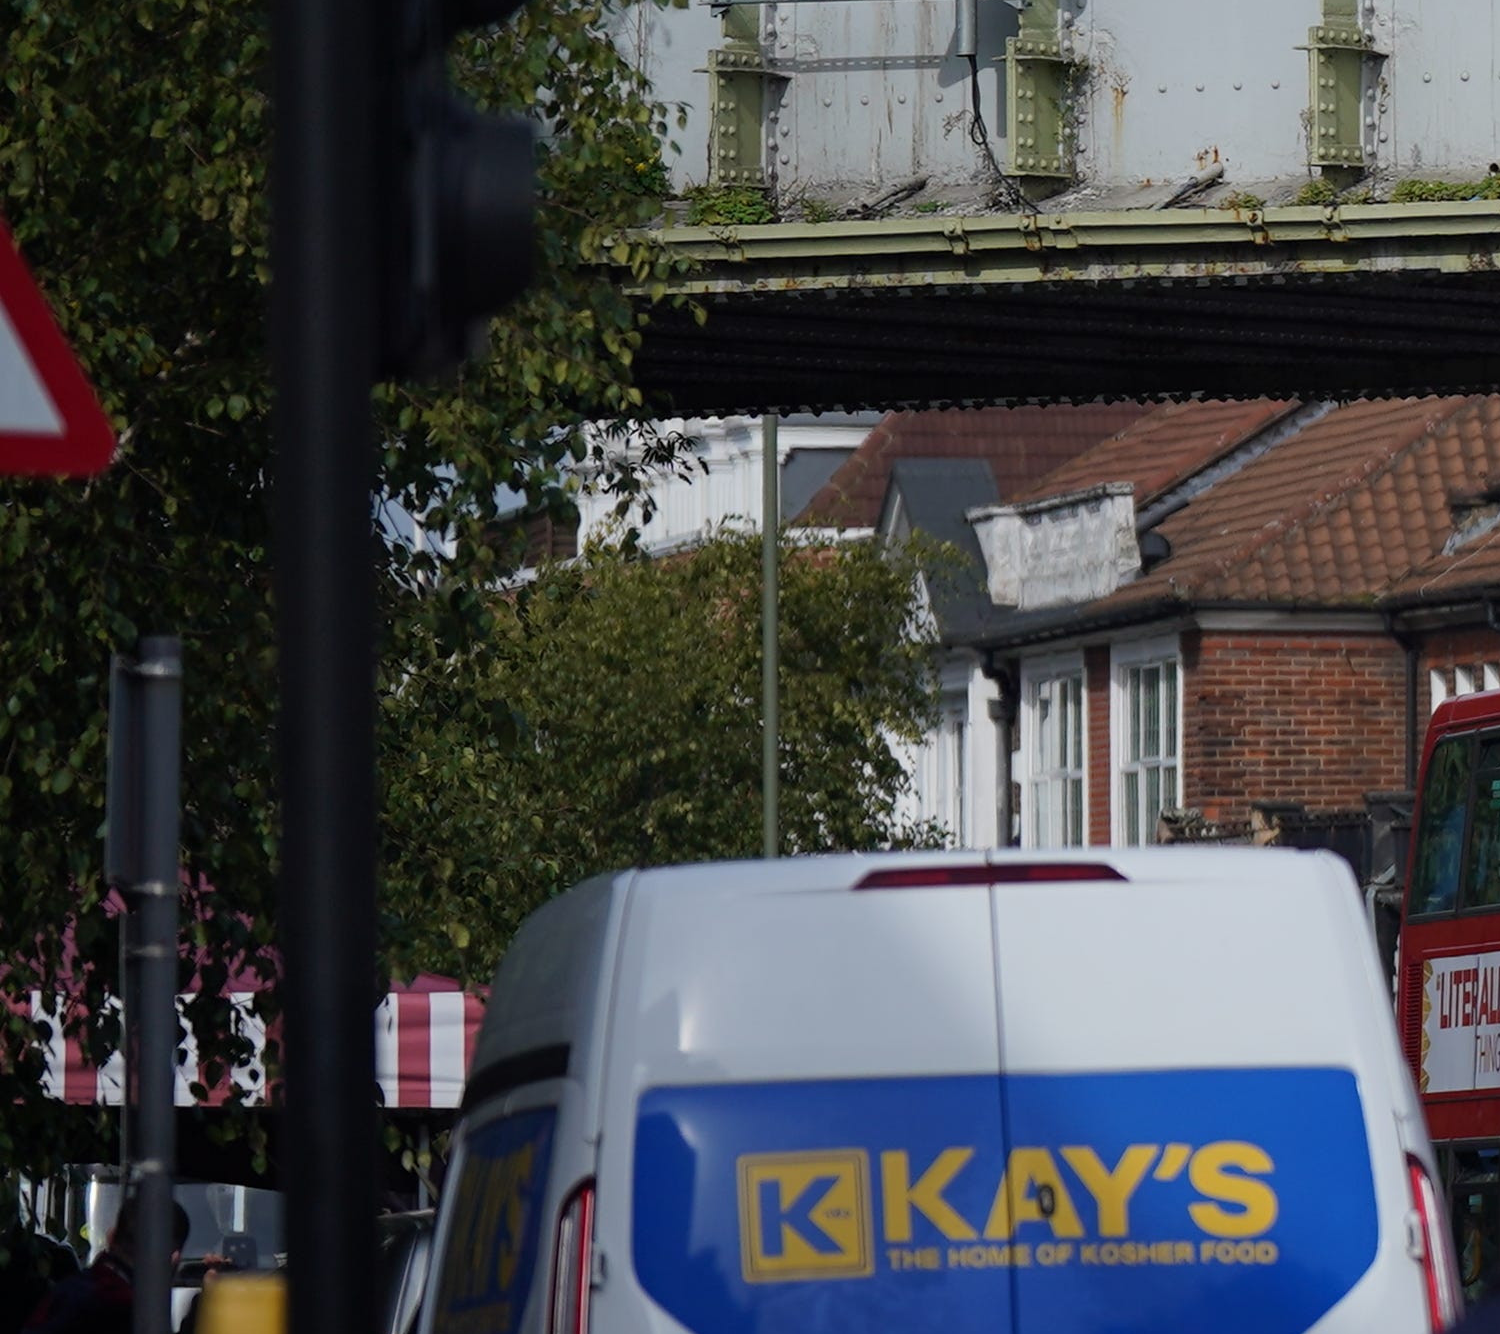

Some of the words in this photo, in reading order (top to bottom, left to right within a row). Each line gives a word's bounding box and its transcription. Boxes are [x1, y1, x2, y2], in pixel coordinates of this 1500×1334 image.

[881, 1140, 1279, 1243] KAY'S
[886, 1246, 944, 1271] THE
[947, 1244, 1032, 1269] HOME
[1035, 1243, 1074, 1267] OF
[1080, 1241, 1197, 1266] KOSHER
[1200, 1240, 1280, 1265] FOOD
